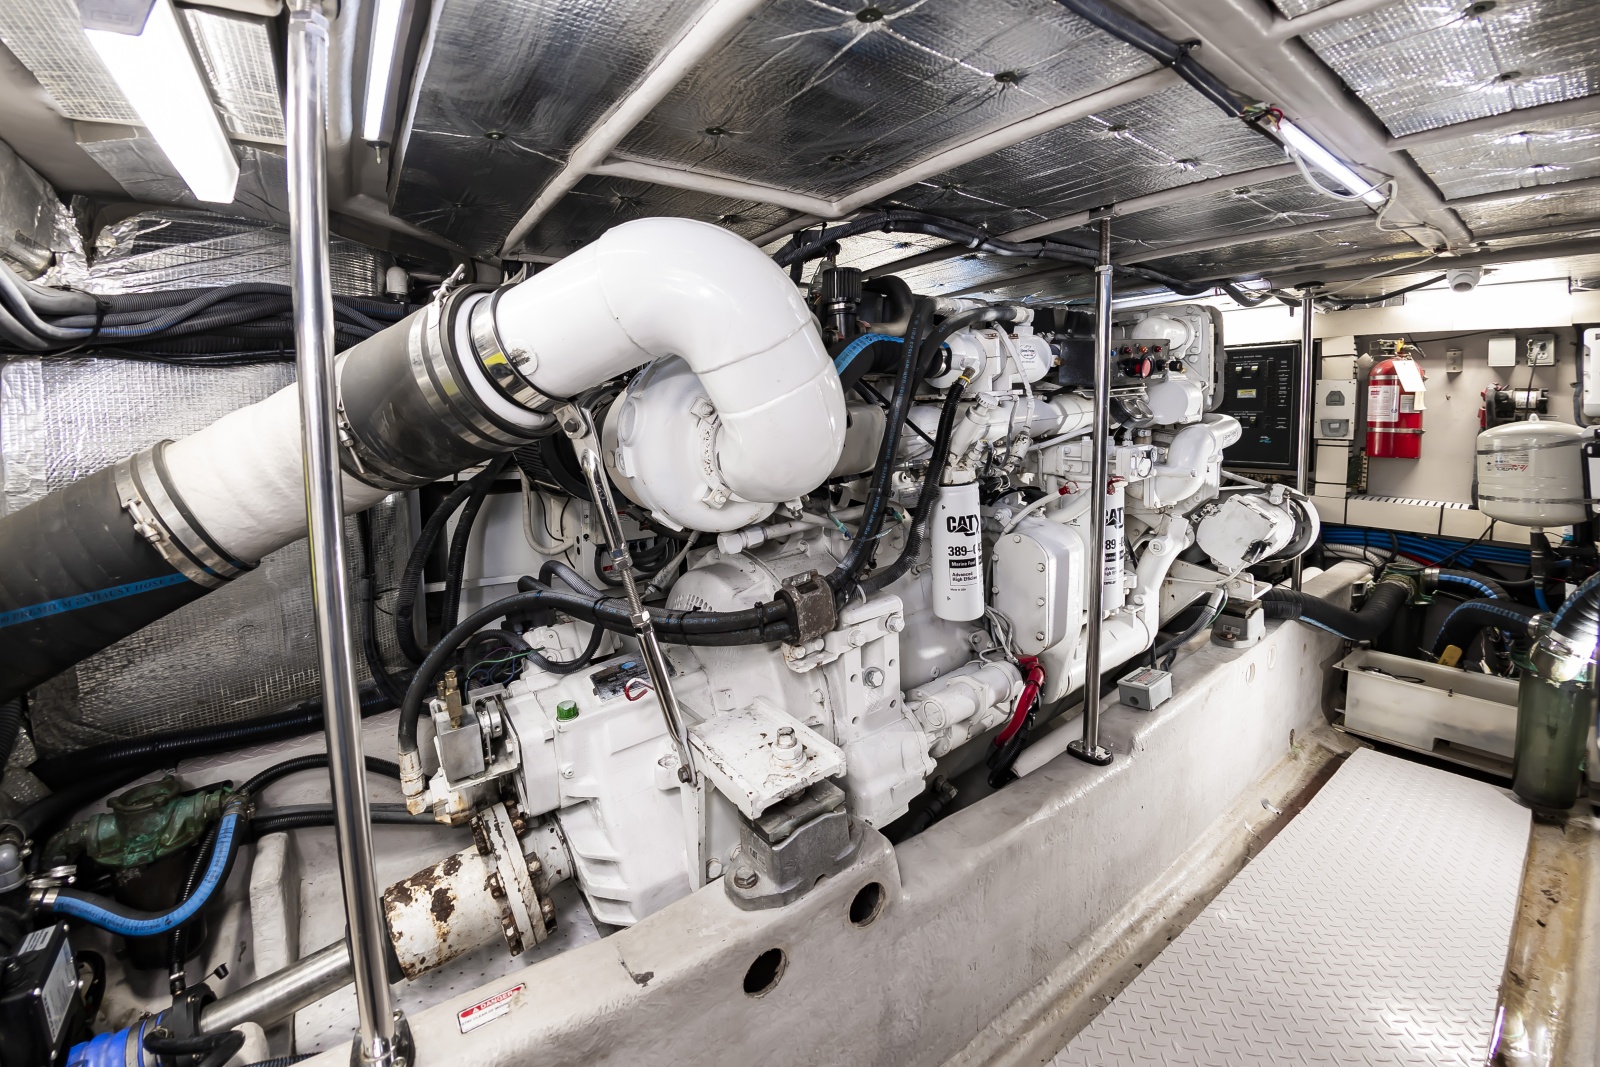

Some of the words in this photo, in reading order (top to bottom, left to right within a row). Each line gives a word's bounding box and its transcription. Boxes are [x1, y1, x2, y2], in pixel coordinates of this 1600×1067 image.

[946, 514, 974, 533] CAT
[12, 599, 72, 621] PREMIUM
[76, 586, 131, 606] EXHAUST
[135, 579, 165, 592] HOSE
[480, 990, 513, 1010] DANGER
